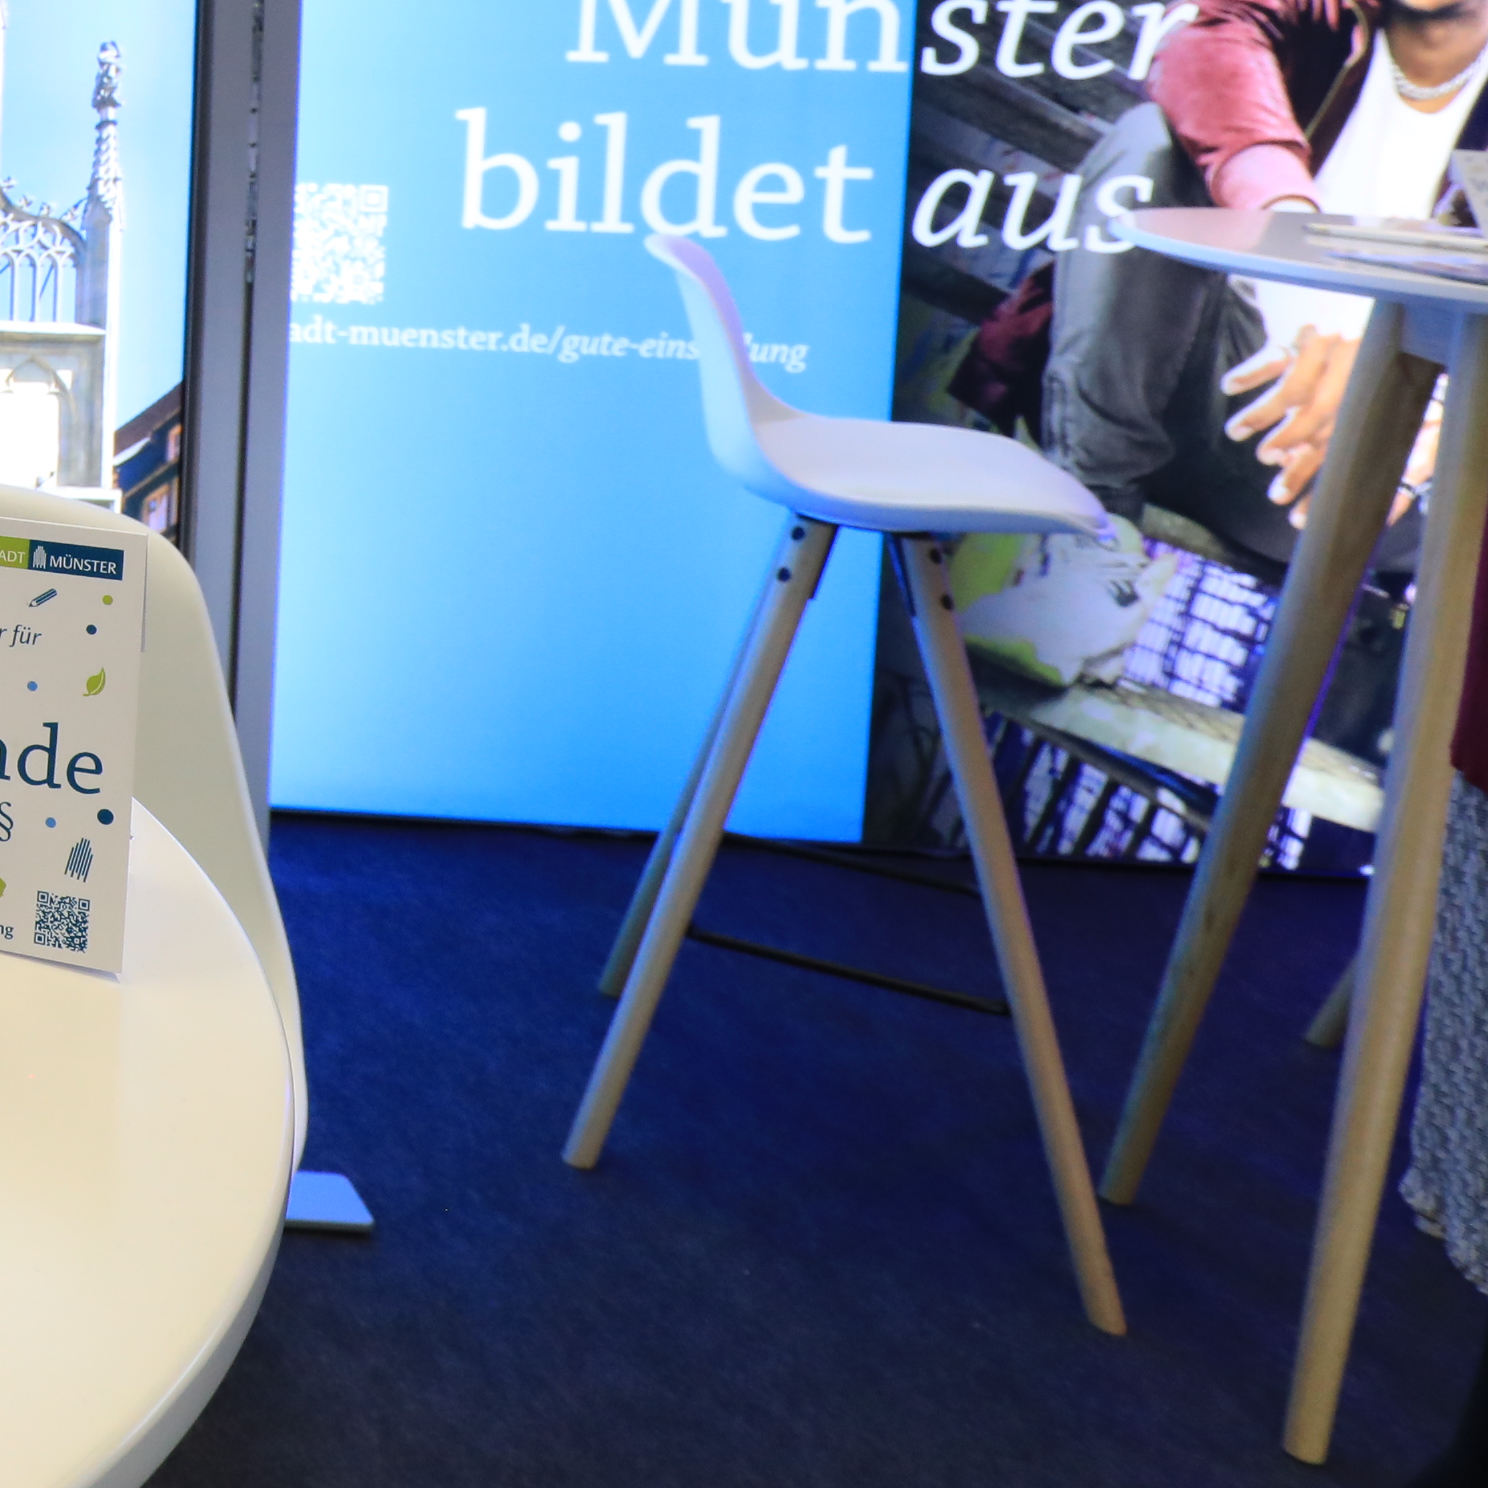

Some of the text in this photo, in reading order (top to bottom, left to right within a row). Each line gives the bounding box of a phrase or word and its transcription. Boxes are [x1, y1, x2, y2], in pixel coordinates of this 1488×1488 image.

[456, 106, 1154, 255] bildet aus
[49, 553, 118, 575] MÜNSTER
[8, 622, 43, 648] für
